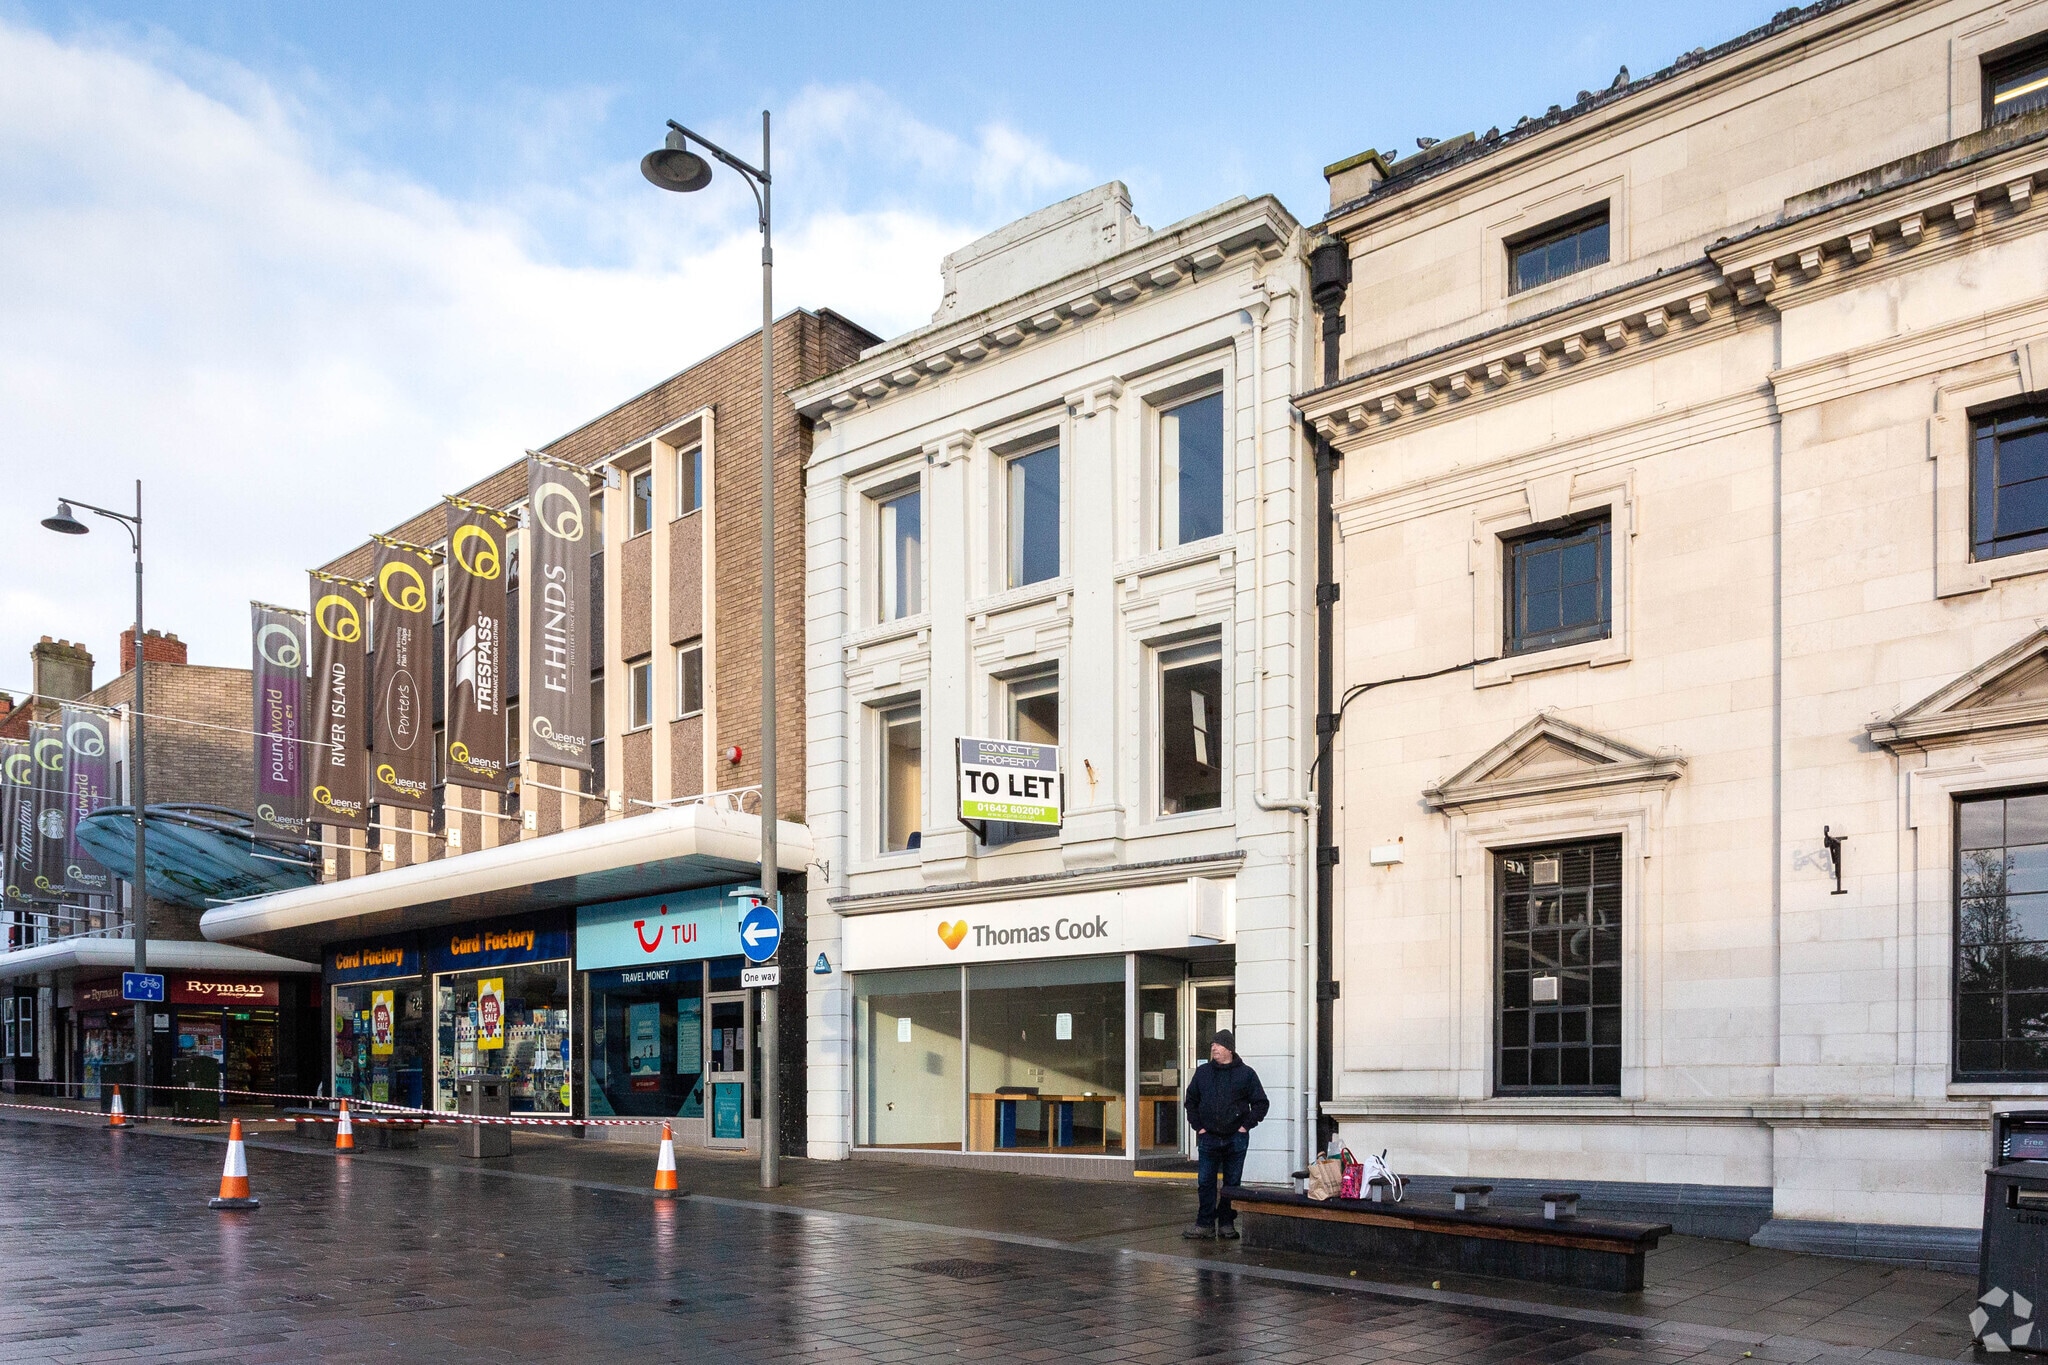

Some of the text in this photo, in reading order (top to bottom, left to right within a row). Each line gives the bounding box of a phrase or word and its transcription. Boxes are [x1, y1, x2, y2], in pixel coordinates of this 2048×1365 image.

[544, 564, 567, 693] F.HINDS
[477, 616, 493, 713] TRESPASS
[332, 663, 346, 767] RIVER ISLAND
[267, 689, 289, 782] poundworld
[286, 705, 295, 771] everything £1
[979, 743, 1032, 755] CONNECT
[979, 755, 1039, 767] PROPERTY
[965, 770, 1054, 799] TO LET
[977, 803, 1046, 816] 01642 602001
[14, 799, 33, 872] Thorntons
[671, 923, 697, 944] TUI
[972, 915, 1108, 947] Thomas Cook
[451, 929, 535, 955] Card Factory
[335, 948, 404, 970] Card Factory
[186, 981, 264, 994] Ryman
[621, 970, 670, 984] TRAVEL MONEY
[744, 972, 777, 983] One way
[91, 988, 119, 1002] Ryman
[377, 1022, 388, 1031] SALE
[485, 1012, 498, 1023] SALE
[2023, 1138, 2044, 1146] Free
